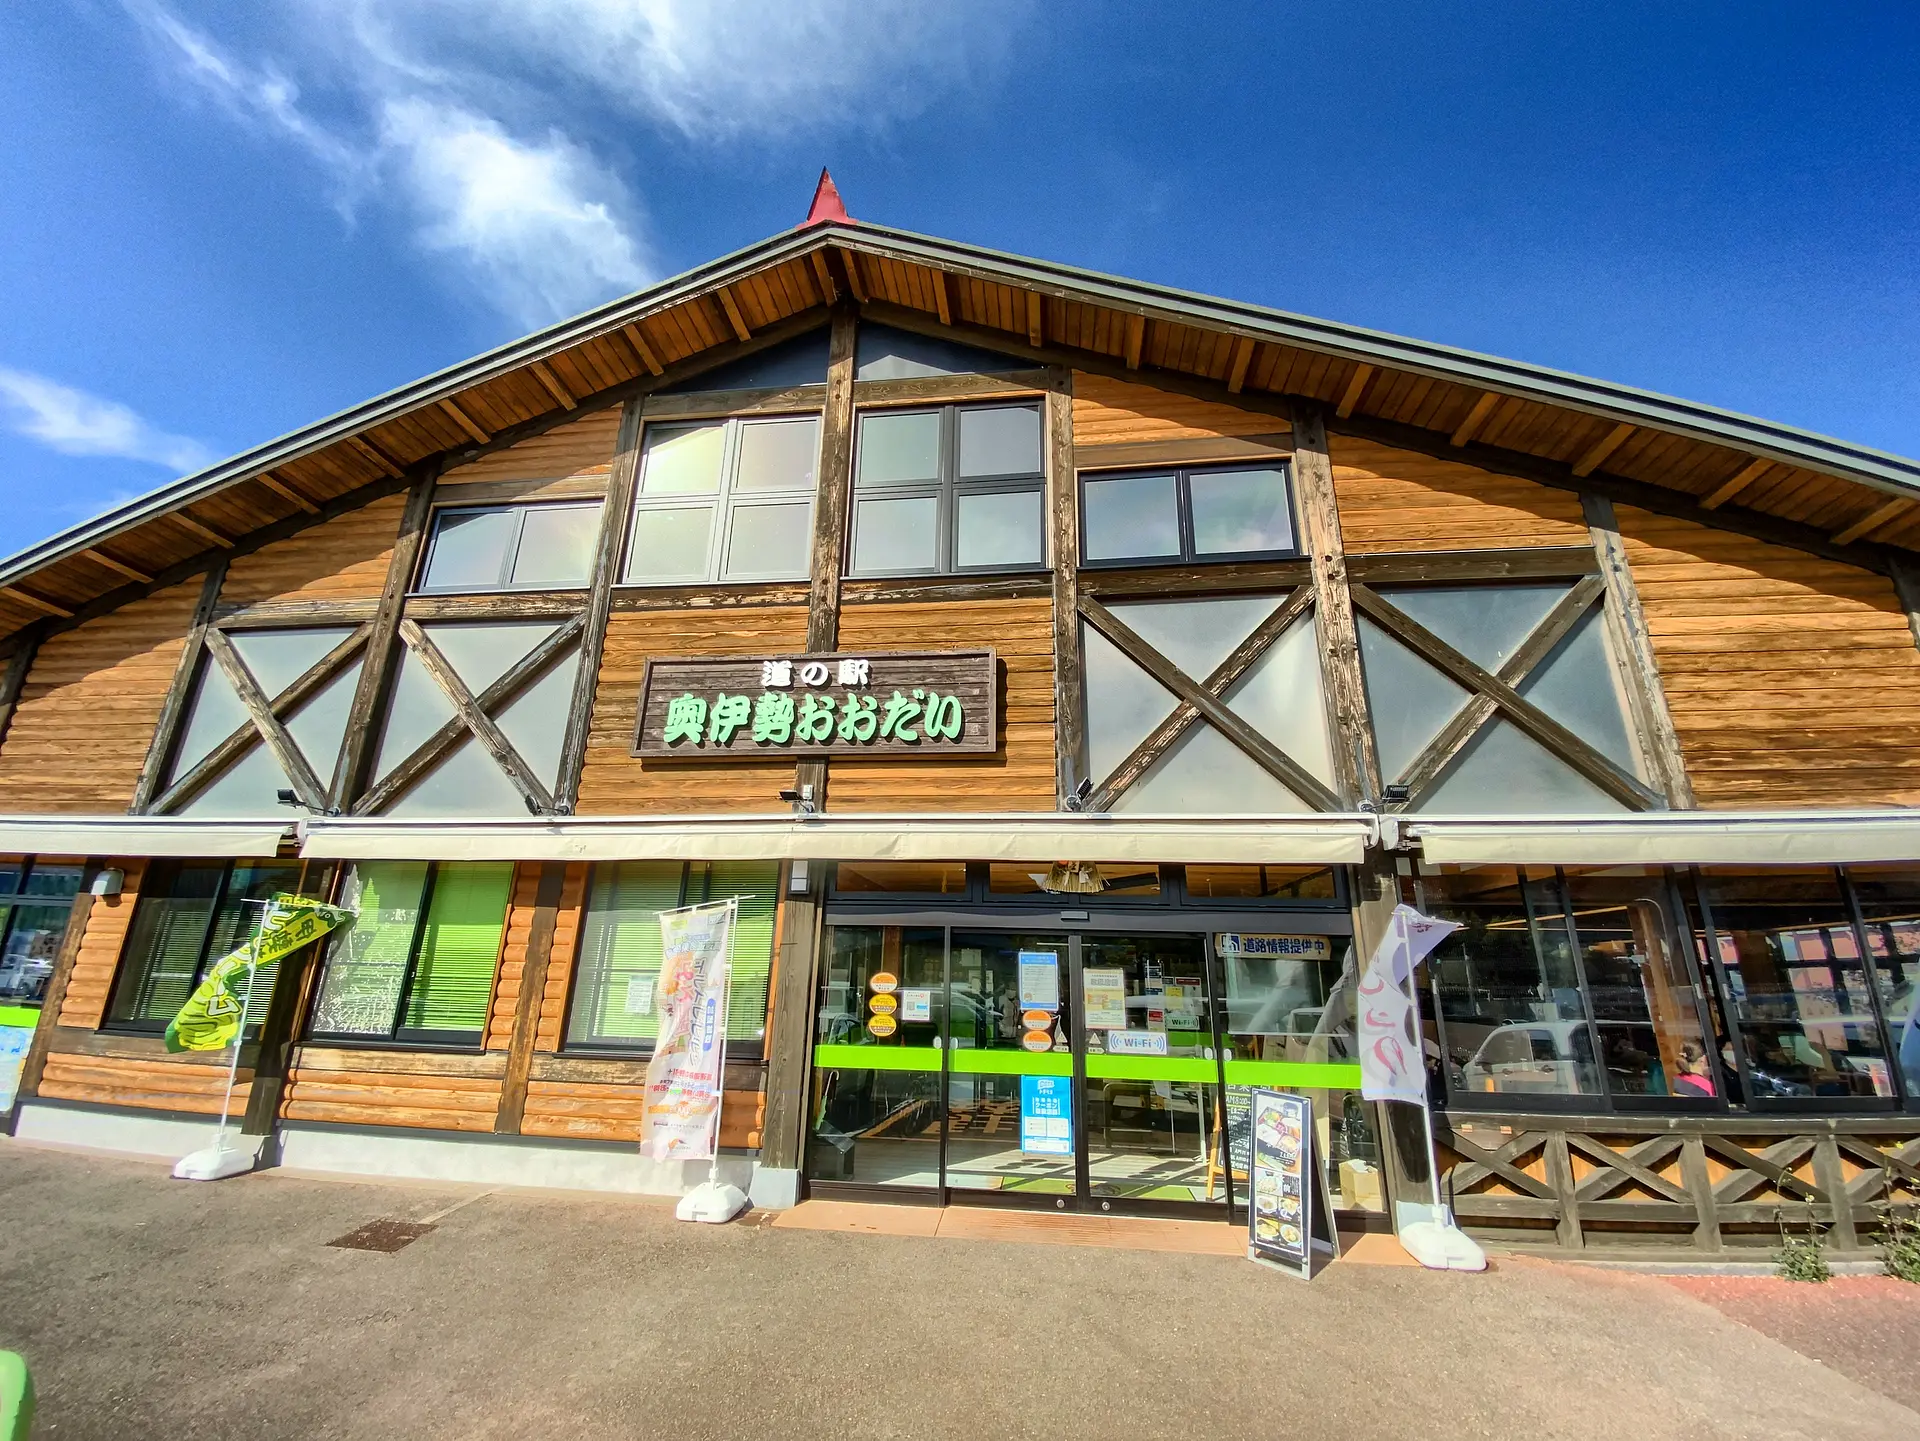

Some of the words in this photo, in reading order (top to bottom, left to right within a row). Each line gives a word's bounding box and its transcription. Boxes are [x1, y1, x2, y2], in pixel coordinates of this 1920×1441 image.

[761, 659, 870, 688] 道の駅
[663, 689, 963, 745] 奥伊勢おおだい
[1243, 937, 1325, 955] 道路情報提供中
[1124, 1038, 1152, 1048] Wi-Fi
